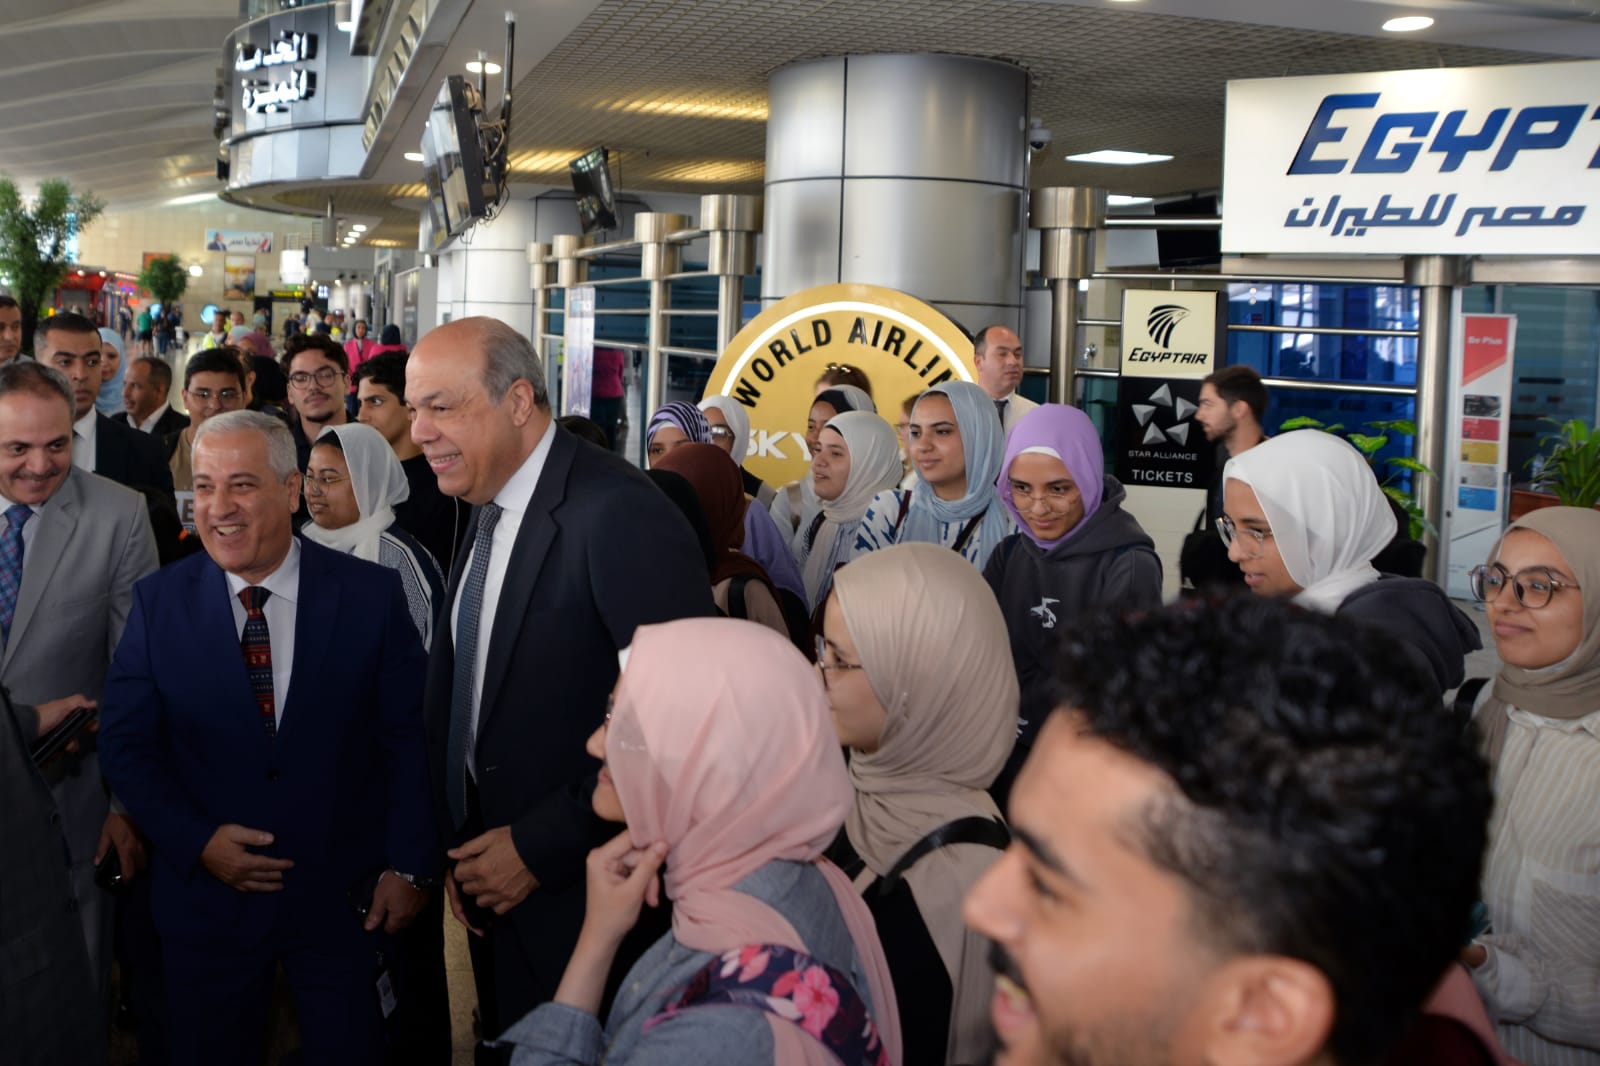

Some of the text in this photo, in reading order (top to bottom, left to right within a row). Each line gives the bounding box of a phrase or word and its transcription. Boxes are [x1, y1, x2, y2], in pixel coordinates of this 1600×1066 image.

[1286, 92, 1600, 175] EGYP
[1283, 193, 1587, 237] مصر للطيران
[733, 318, 833, 409] WORLD
[1128, 347, 1209, 365] EGYPTAIR
[746, 428, 813, 462] SKY
[1128, 450, 1198, 461] STAR ALLIANCE
[1132, 469, 1193, 483] TICKETS
